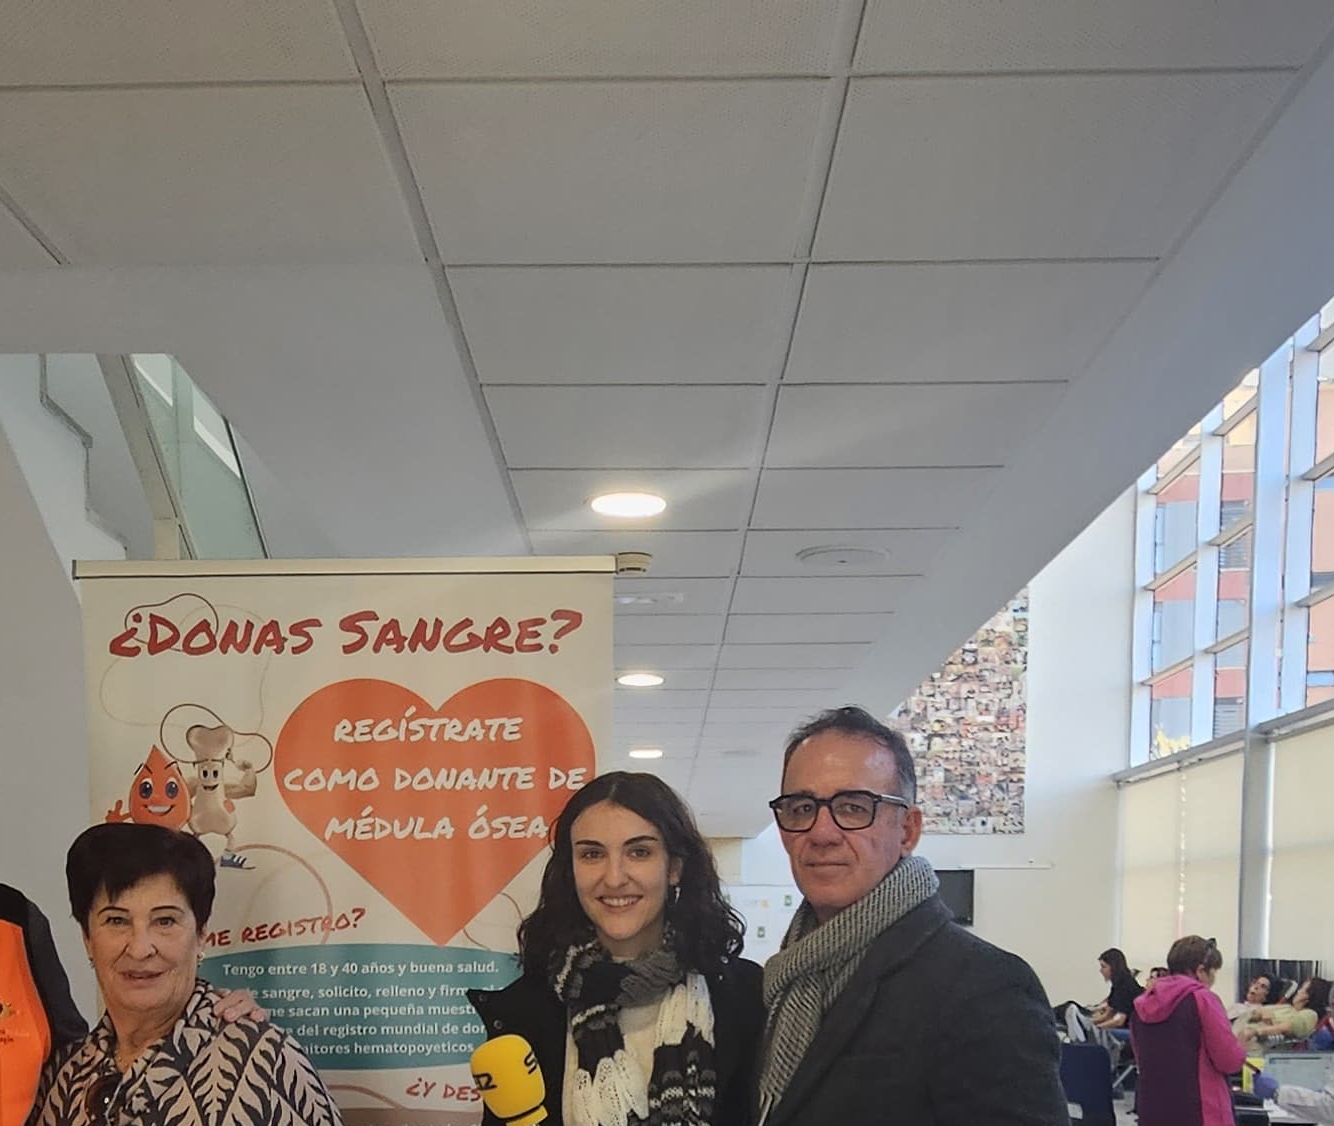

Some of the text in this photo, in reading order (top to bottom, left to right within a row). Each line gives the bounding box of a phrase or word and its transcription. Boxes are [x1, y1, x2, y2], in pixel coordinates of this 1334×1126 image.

[109, 609, 583, 657] ¿DONAS SANGRE?
[334, 706, 523, 743] REGÍSTRATE
[284, 766, 587, 792] COMO DONANTE DE
[325, 805, 549, 840] MÉDULA ÓSEA
[241, 908, 366, 943] REGISTRO?
[222, 961, 499, 977] Tengo entre 18 y 40 años y buena salud.
[262, 988, 314, 1001] sangre,
[318, 985, 372, 999] solicito,
[375, 985, 425, 997] relleno
[427, 986, 437, 999] y
[439, 984, 471, 997] firm
[288, 1006, 329, 1017] sacan
[334, 1006, 360, 1016] una
[363, 1003, 424, 1019] pequeña
[297, 1024, 319, 1036] del
[323, 1023, 377, 1039] registro
[380, 1022, 438, 1035] mundial
[441, 1022, 459, 1034] de
[354, 1041, 474, 1057] hematopoyeticos
[406, 1077, 437, 1097] ¿Y
